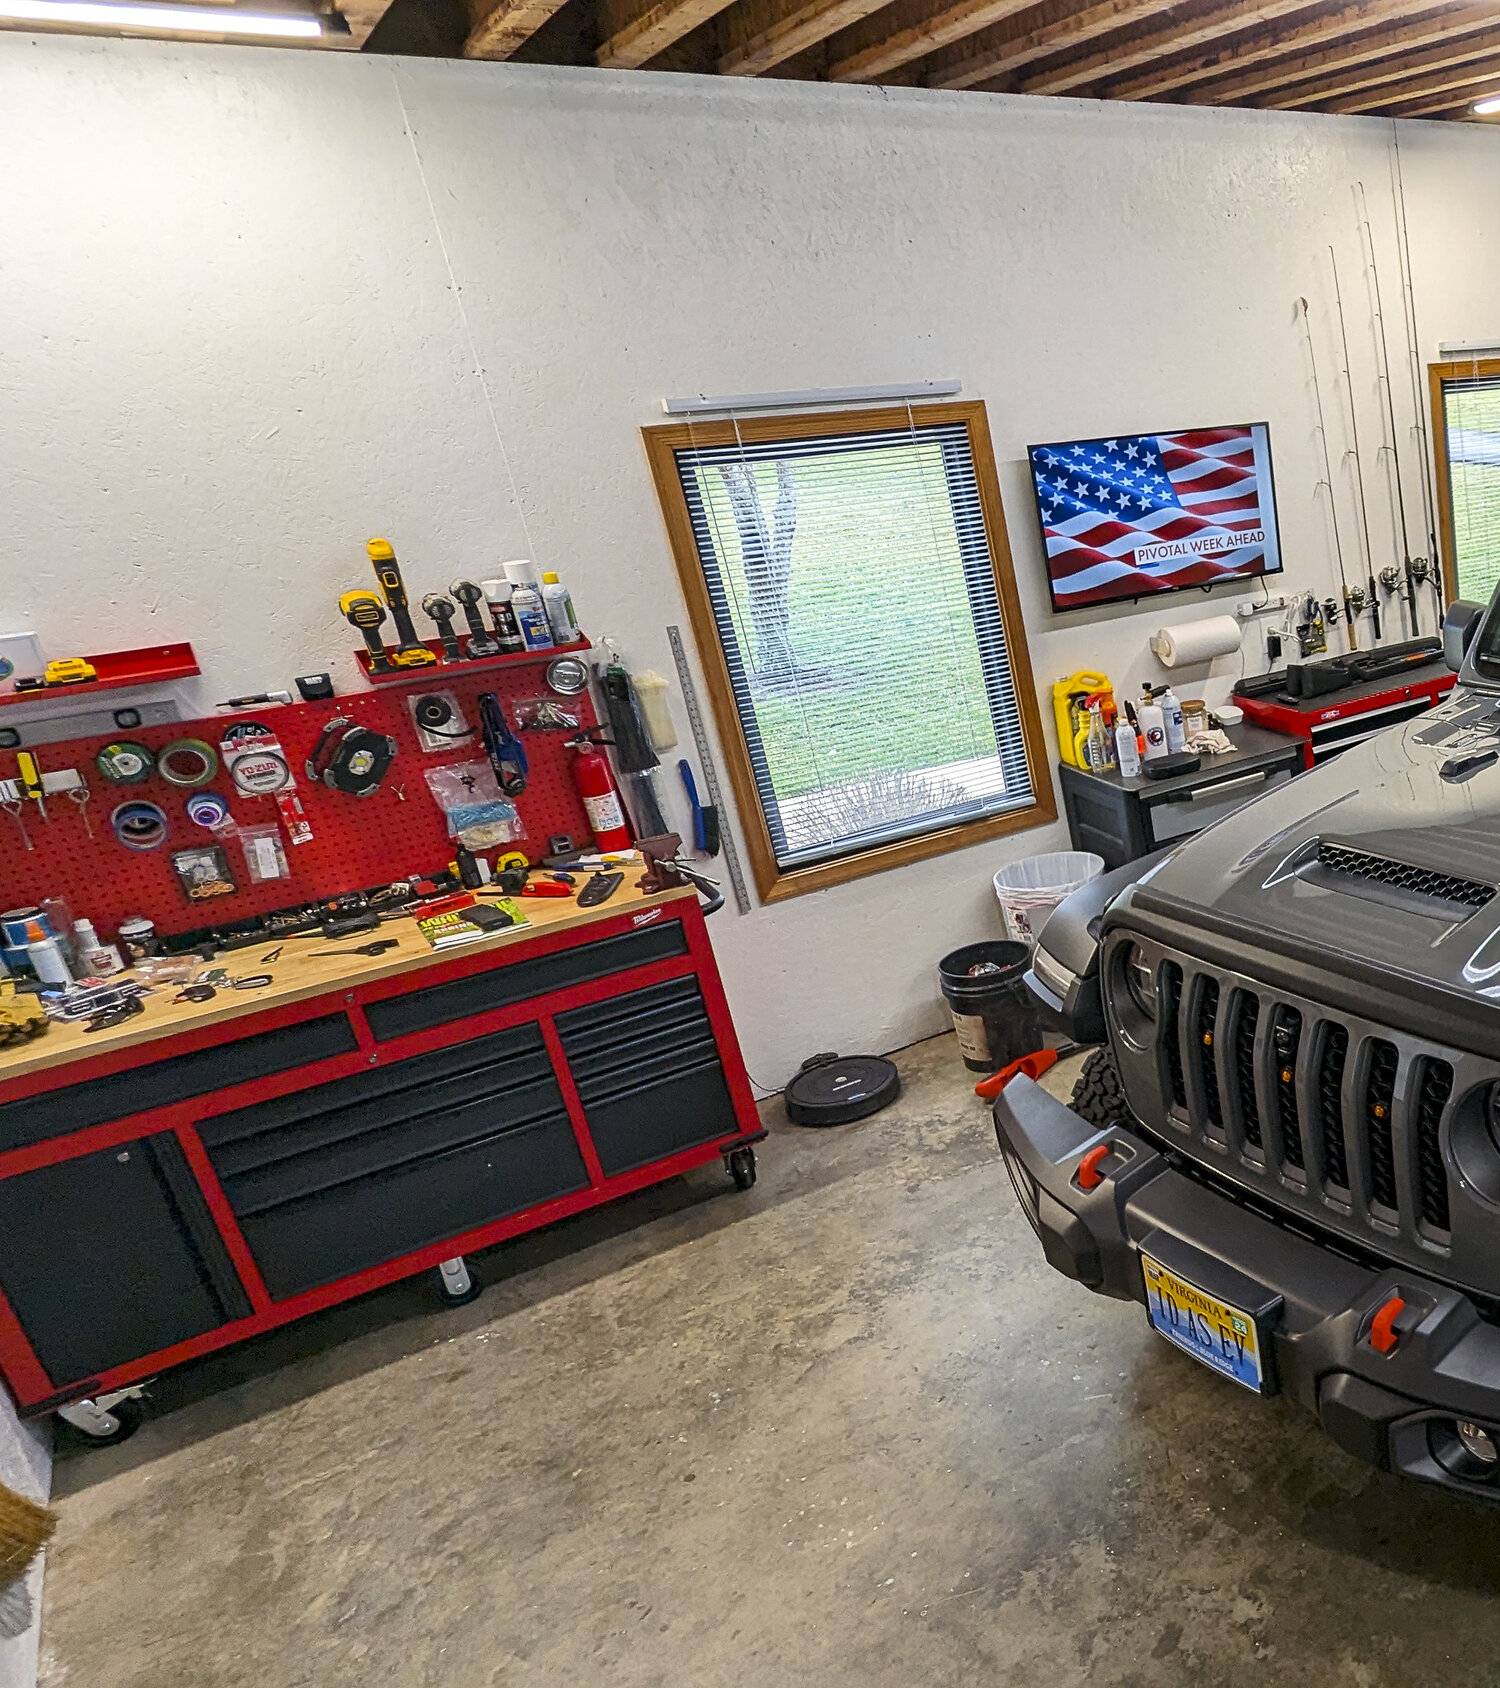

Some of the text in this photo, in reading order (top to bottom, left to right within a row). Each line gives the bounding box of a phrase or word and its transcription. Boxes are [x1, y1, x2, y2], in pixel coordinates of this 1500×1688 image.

[1138, 531, 1265, 561] PIVOTAL WEEK AHEAD
[1167, 1277, 1222, 1320] VIRGINIA
